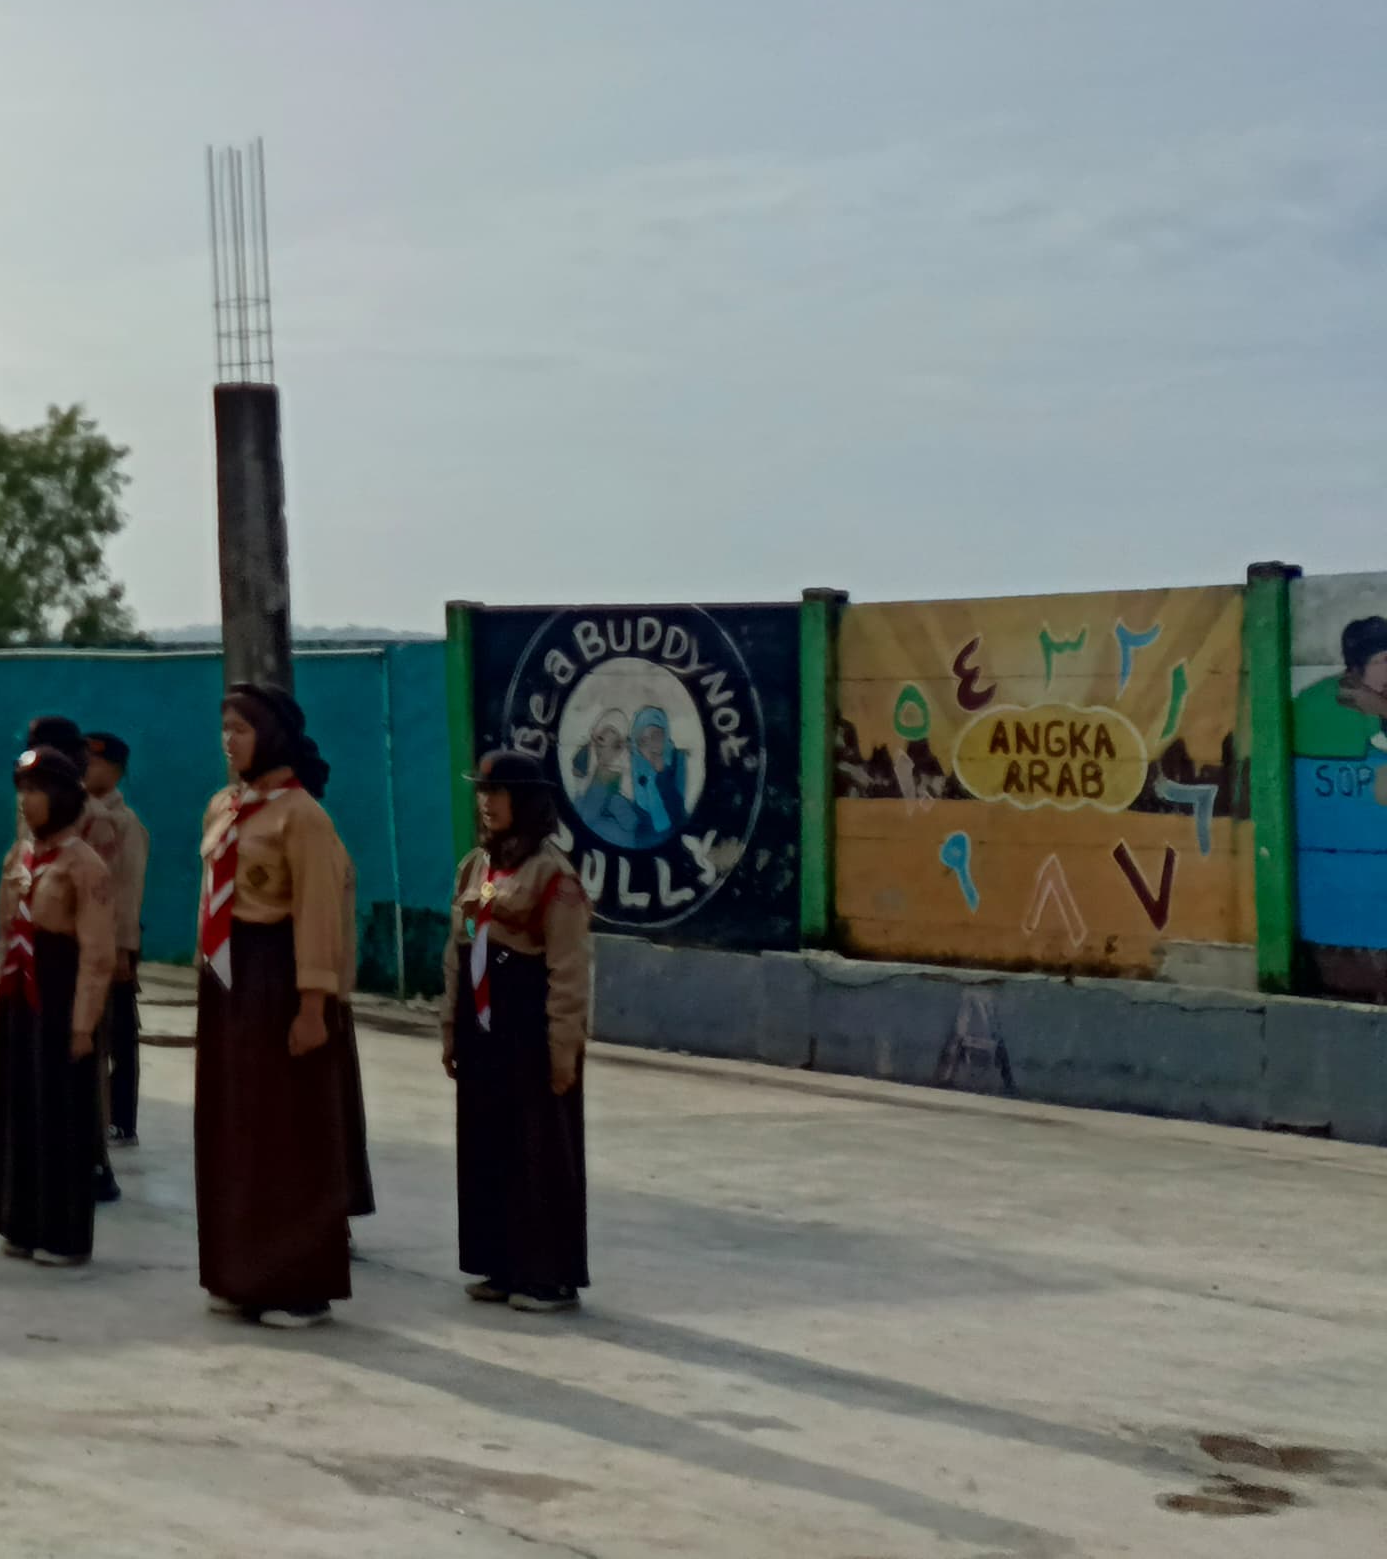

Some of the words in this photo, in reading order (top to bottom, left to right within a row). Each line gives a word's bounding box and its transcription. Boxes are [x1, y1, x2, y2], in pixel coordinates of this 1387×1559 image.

[543, 647, 577, 686] a
[571, 615, 714, 674] BUDDY
[989, 719, 1116, 760] ANGKA
[1002, 759, 1106, 799] ARAB
